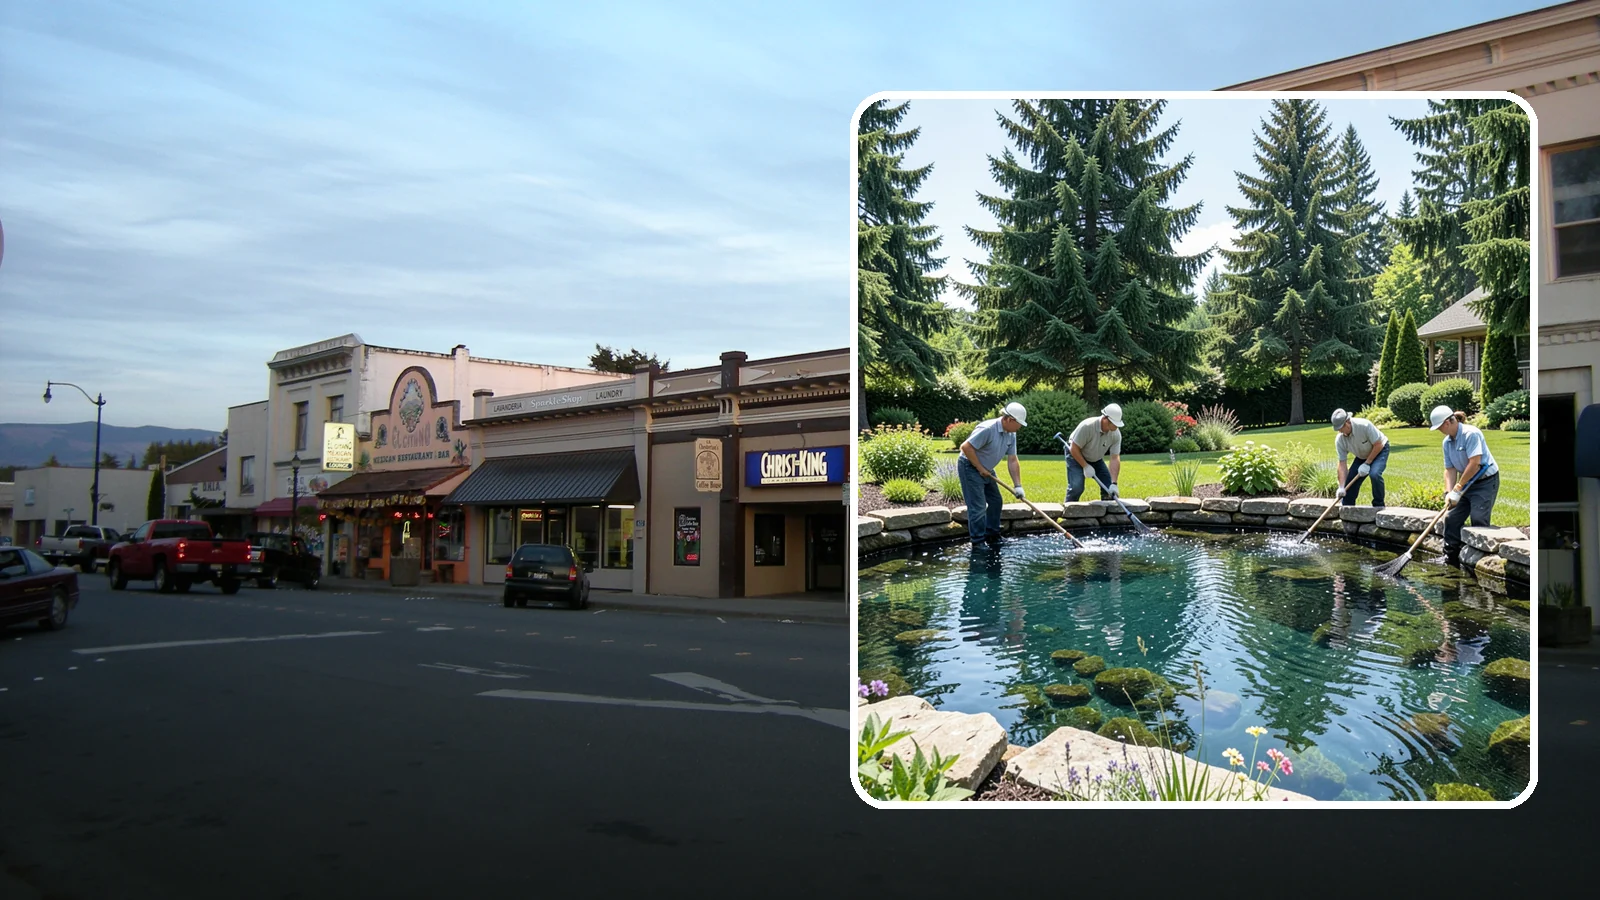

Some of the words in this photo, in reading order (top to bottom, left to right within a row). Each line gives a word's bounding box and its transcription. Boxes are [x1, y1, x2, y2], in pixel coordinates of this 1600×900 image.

[530, 396, 561, 409] Sparkle
[561, 394, 583, 406] Shop
[595, 389, 624, 400] LAUNDRY
[494, 402, 523, 412] LAVANDERIA
[373, 455, 396, 464] MEXICAN
[397, 451, 433, 462] RESTAURANT
[438, 450, 450, 459] BAR
[761, 452, 797, 478] CHRIST
[799, 450, 828, 476] KING
